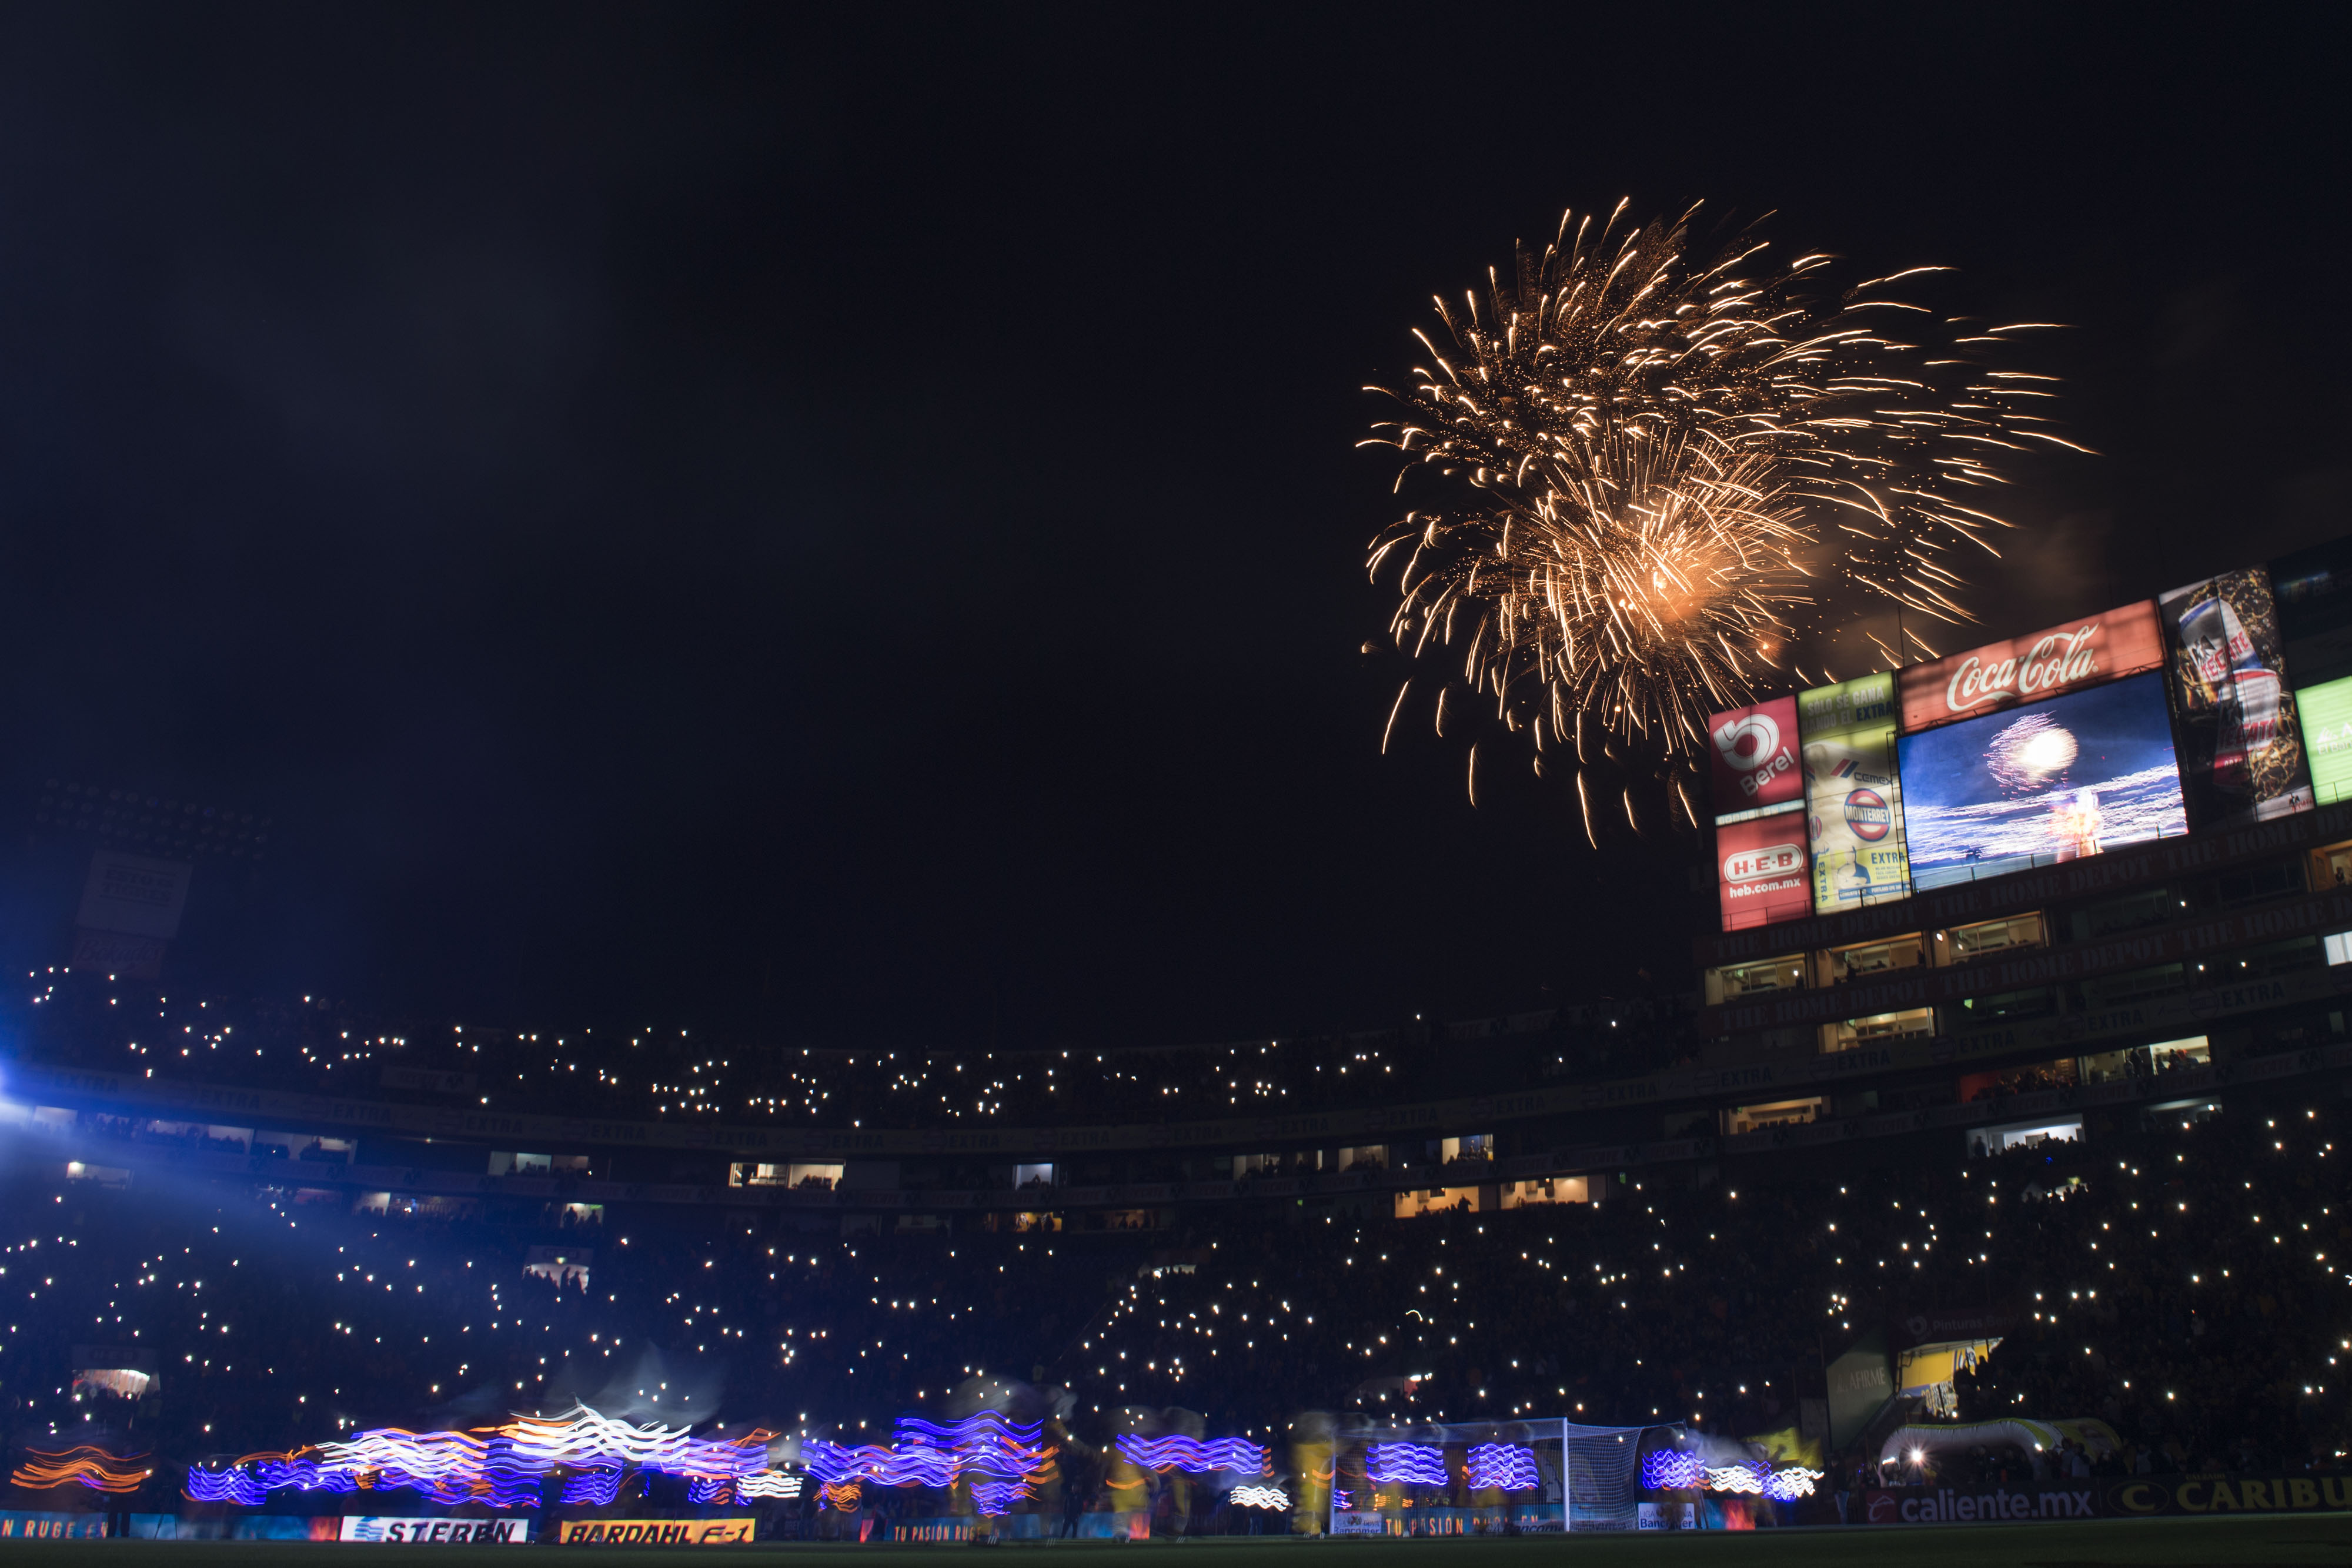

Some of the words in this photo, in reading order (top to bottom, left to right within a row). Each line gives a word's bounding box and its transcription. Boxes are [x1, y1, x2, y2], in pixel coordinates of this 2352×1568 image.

[1947, 622, 2099, 711] Coca-Cola
[2201, 631, 2249, 681] TECATE
[1808, 697, 1832, 716] SÓLO
[1836, 693, 1849, 710] SE
[1853, 686, 1885, 706] GANA
[1841, 710, 1852, 725] EL
[1856, 701, 1894, 721] EXTRA
[1740, 746, 1794, 796] Berel
[1854, 771, 1892, 785] CEMEX
[1845, 805, 1889, 823] MONTERREY
[1734, 852, 1793, 875] H-E-B
[1871, 852, 1906, 864] EXTRA
[1729, 878, 1800, 898] heb.com.mx
[1819, 861, 1828, 902] EXTRA
[1850, 977, 1929, 1011] DEPOT
[2080, 934, 2168, 971] DEPOT
[2221, 981, 2286, 1008] EXTRA
[2088, 1008, 2144, 1032] EXTRA
[1960, 1030, 2016, 1054] EXTRA
[1838, 1048, 1891, 1071] EXTRA
[1721, 1065, 1773, 1087] EXTRA
[1608, 1082, 1658, 1101] EXTRA
[591, 1124, 646, 1141] EXTRA
[714, 1131, 768, 1146] EXTRA
[832, 1132, 884, 1149] EXTRA
[949, 1133, 1000, 1149] EXTRA
[1061, 1129, 1110, 1146] EXTRA
[1933, 1316, 1983, 1332] Pinturas
[1850, 1367, 1886, 1389] AFIRME
[1901, 1488, 2094, 1522] caliente.mx
[2176, 1476, 2352, 1512] CARIBU
[25, 1519, 75, 1539] RUGE
[386, 1521, 517, 1543] STEREN
[567, 1524, 692, 1544] BARDAHL
[894, 1526, 907, 1542] TU
[912, 1523, 950, 1542] PASIÓN
[1385, 1519, 1402, 1536] TU
[1641, 1519, 1693, 1528] Bancer
